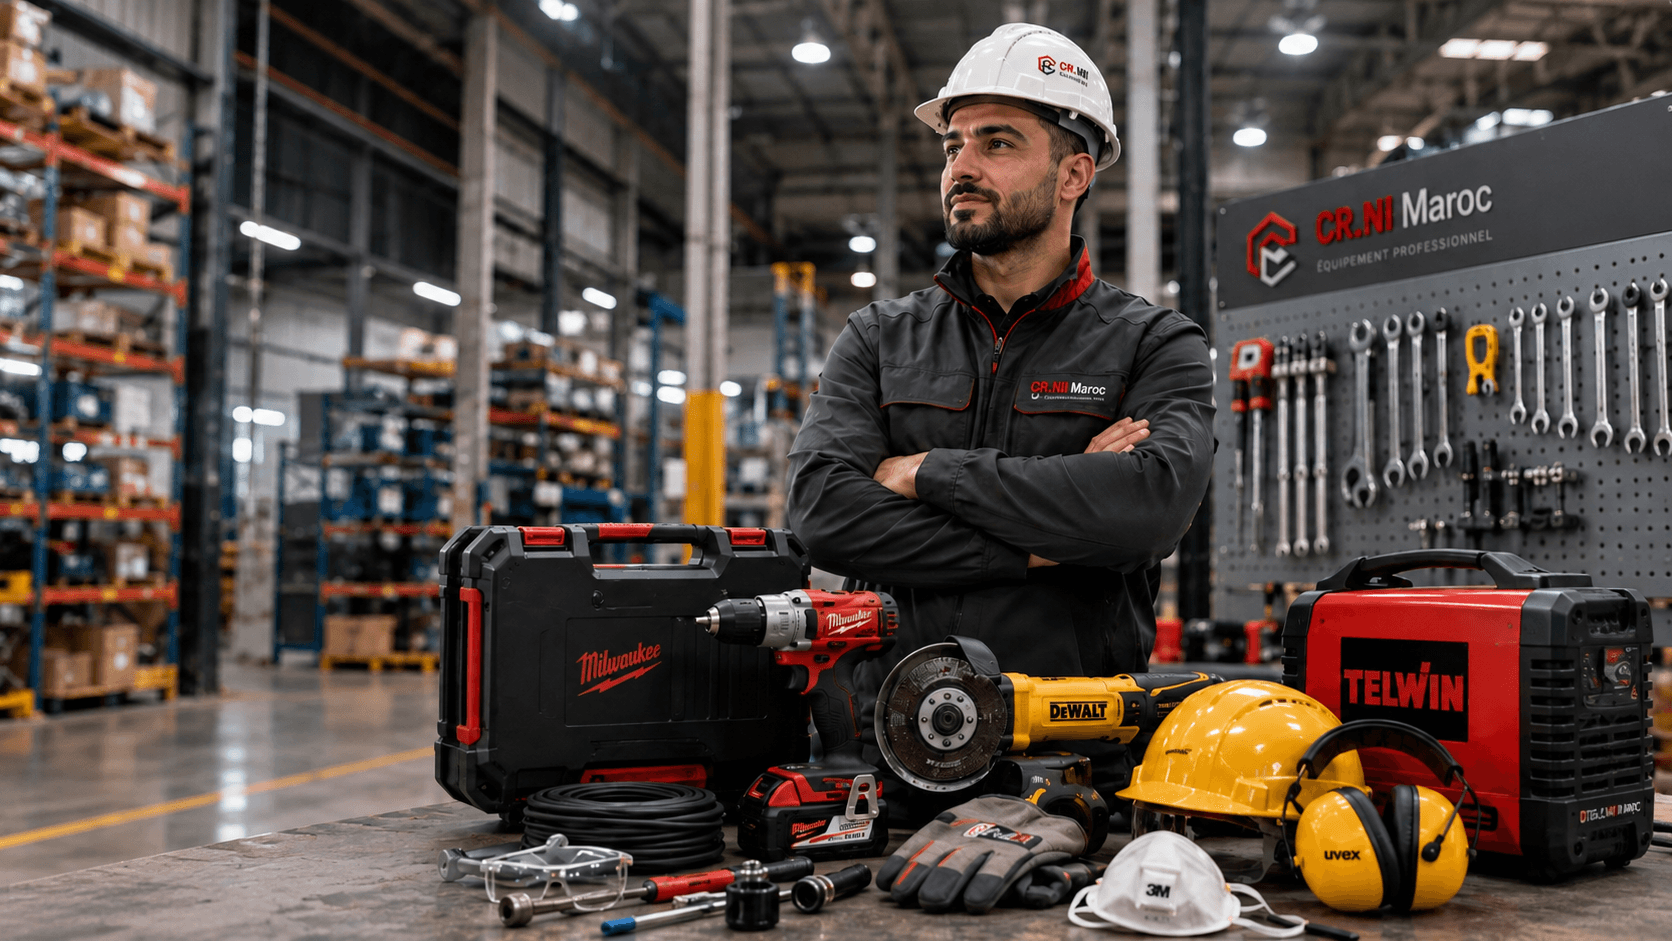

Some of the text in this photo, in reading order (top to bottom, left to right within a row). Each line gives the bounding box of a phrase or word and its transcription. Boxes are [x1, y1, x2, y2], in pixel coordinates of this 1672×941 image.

[1315, 185, 1493, 245] CR.NI Maroc
[1392, 229, 1493, 258] PROFESSIONNEL
[1070, 381, 1106, 396] Maroc
[576, 641, 661, 686] Milwaukee
[1343, 661, 1465, 713] TELWIN
[1323, 849, 1361, 861] uvex
[1145, 883, 1171, 899] 3M
